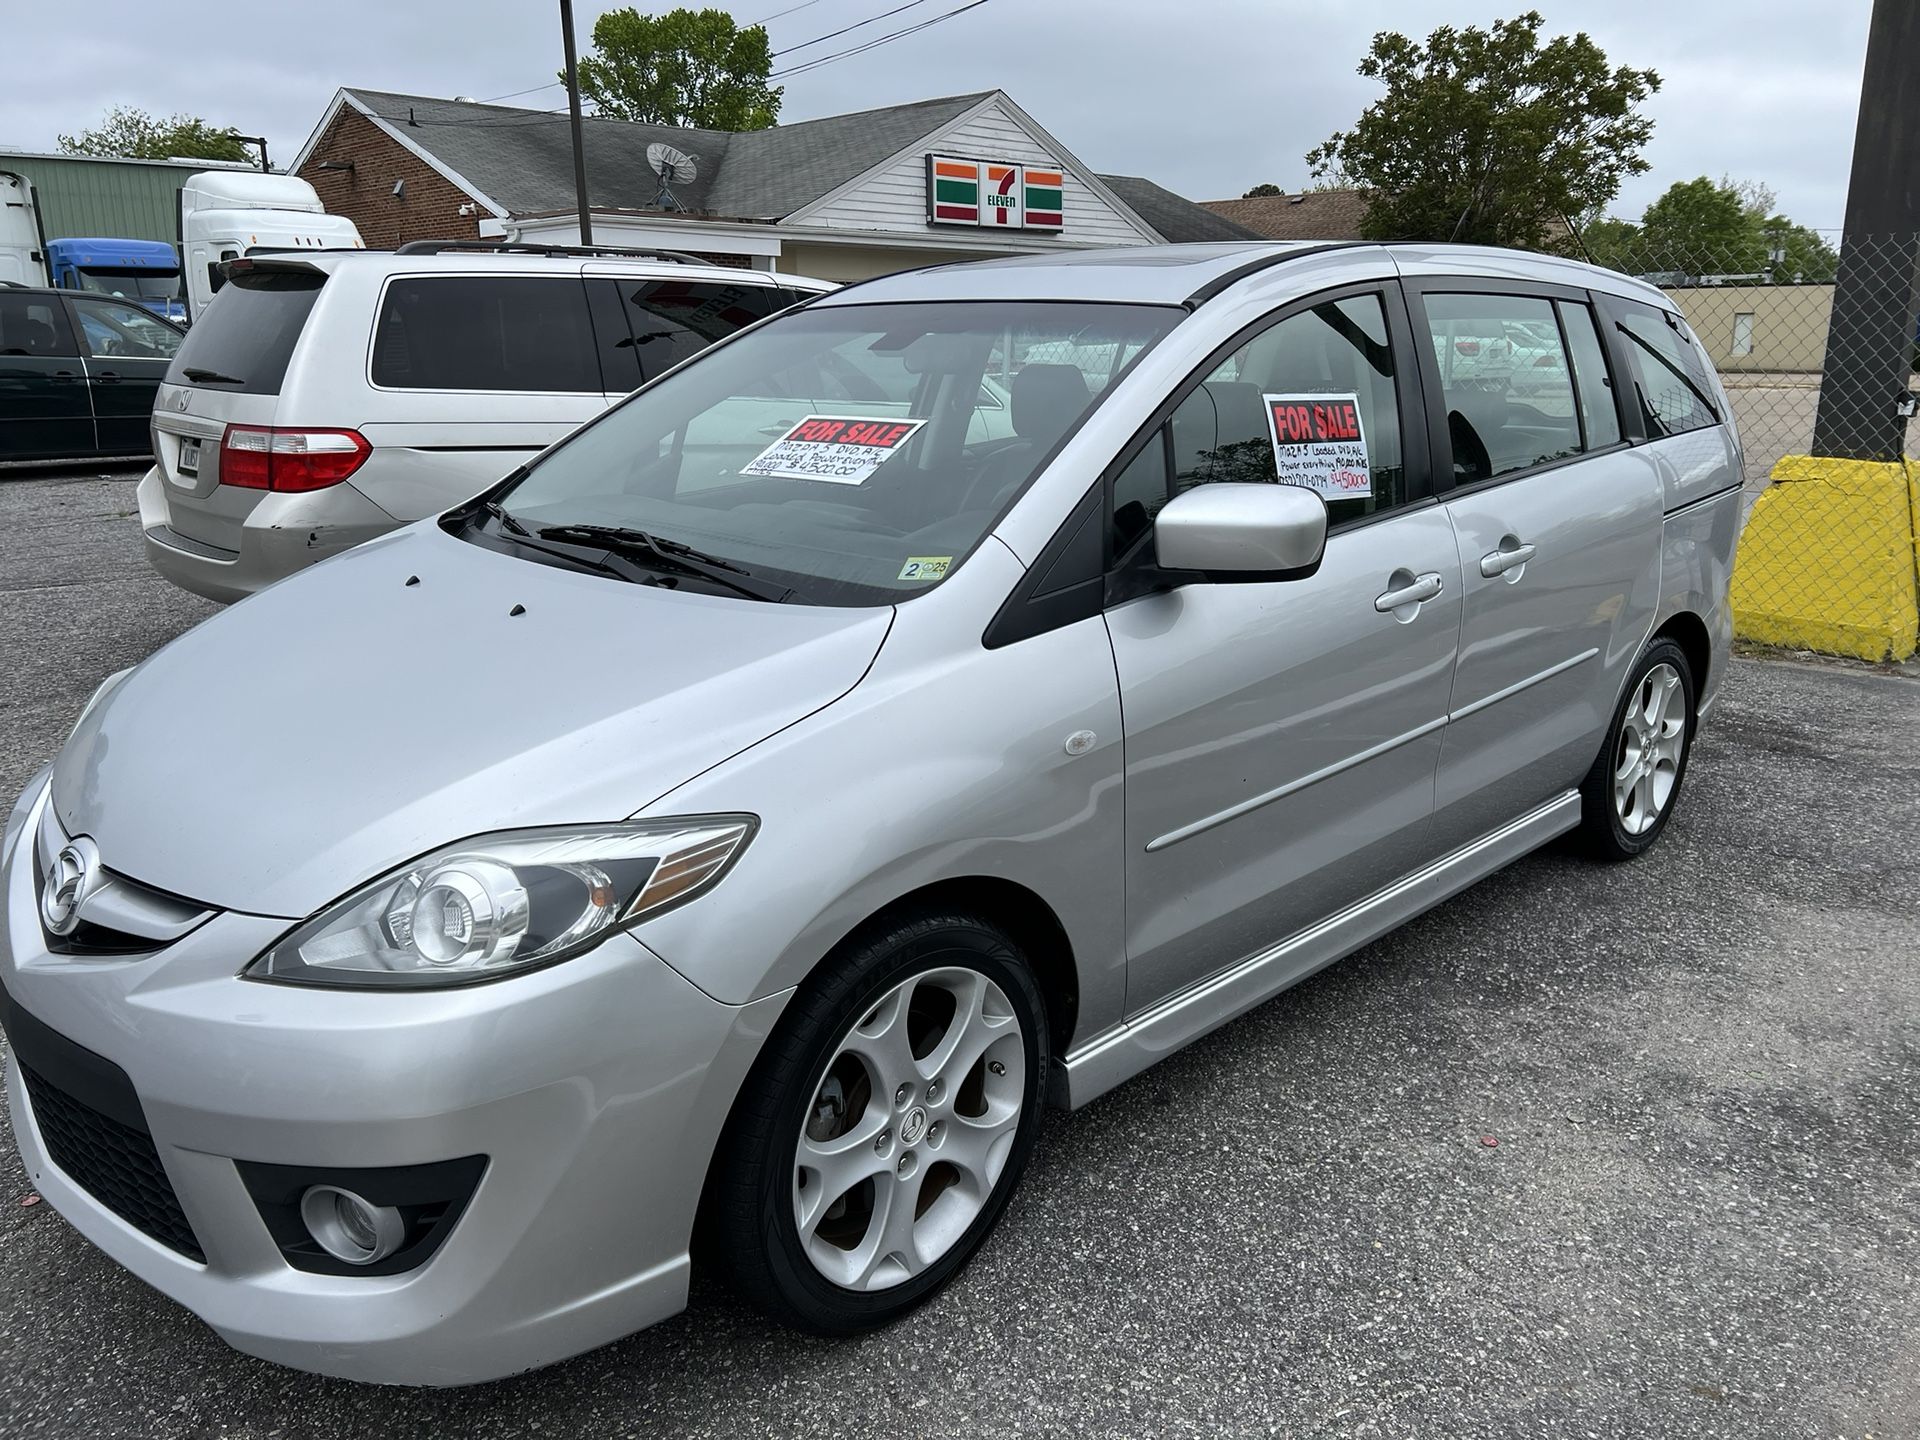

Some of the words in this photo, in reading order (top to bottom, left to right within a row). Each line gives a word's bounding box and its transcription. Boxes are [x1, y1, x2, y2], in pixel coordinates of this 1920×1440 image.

[996, 168, 1016, 224] 7
[790, 420, 845, 443] FOR
[838, 422, 909, 446] SALE
[1274, 406, 1313, 441] FOR
[1314, 404, 1358, 439] SALE
[905, 563, 920, 576] 2
[933, 562, 948, 572] 25
